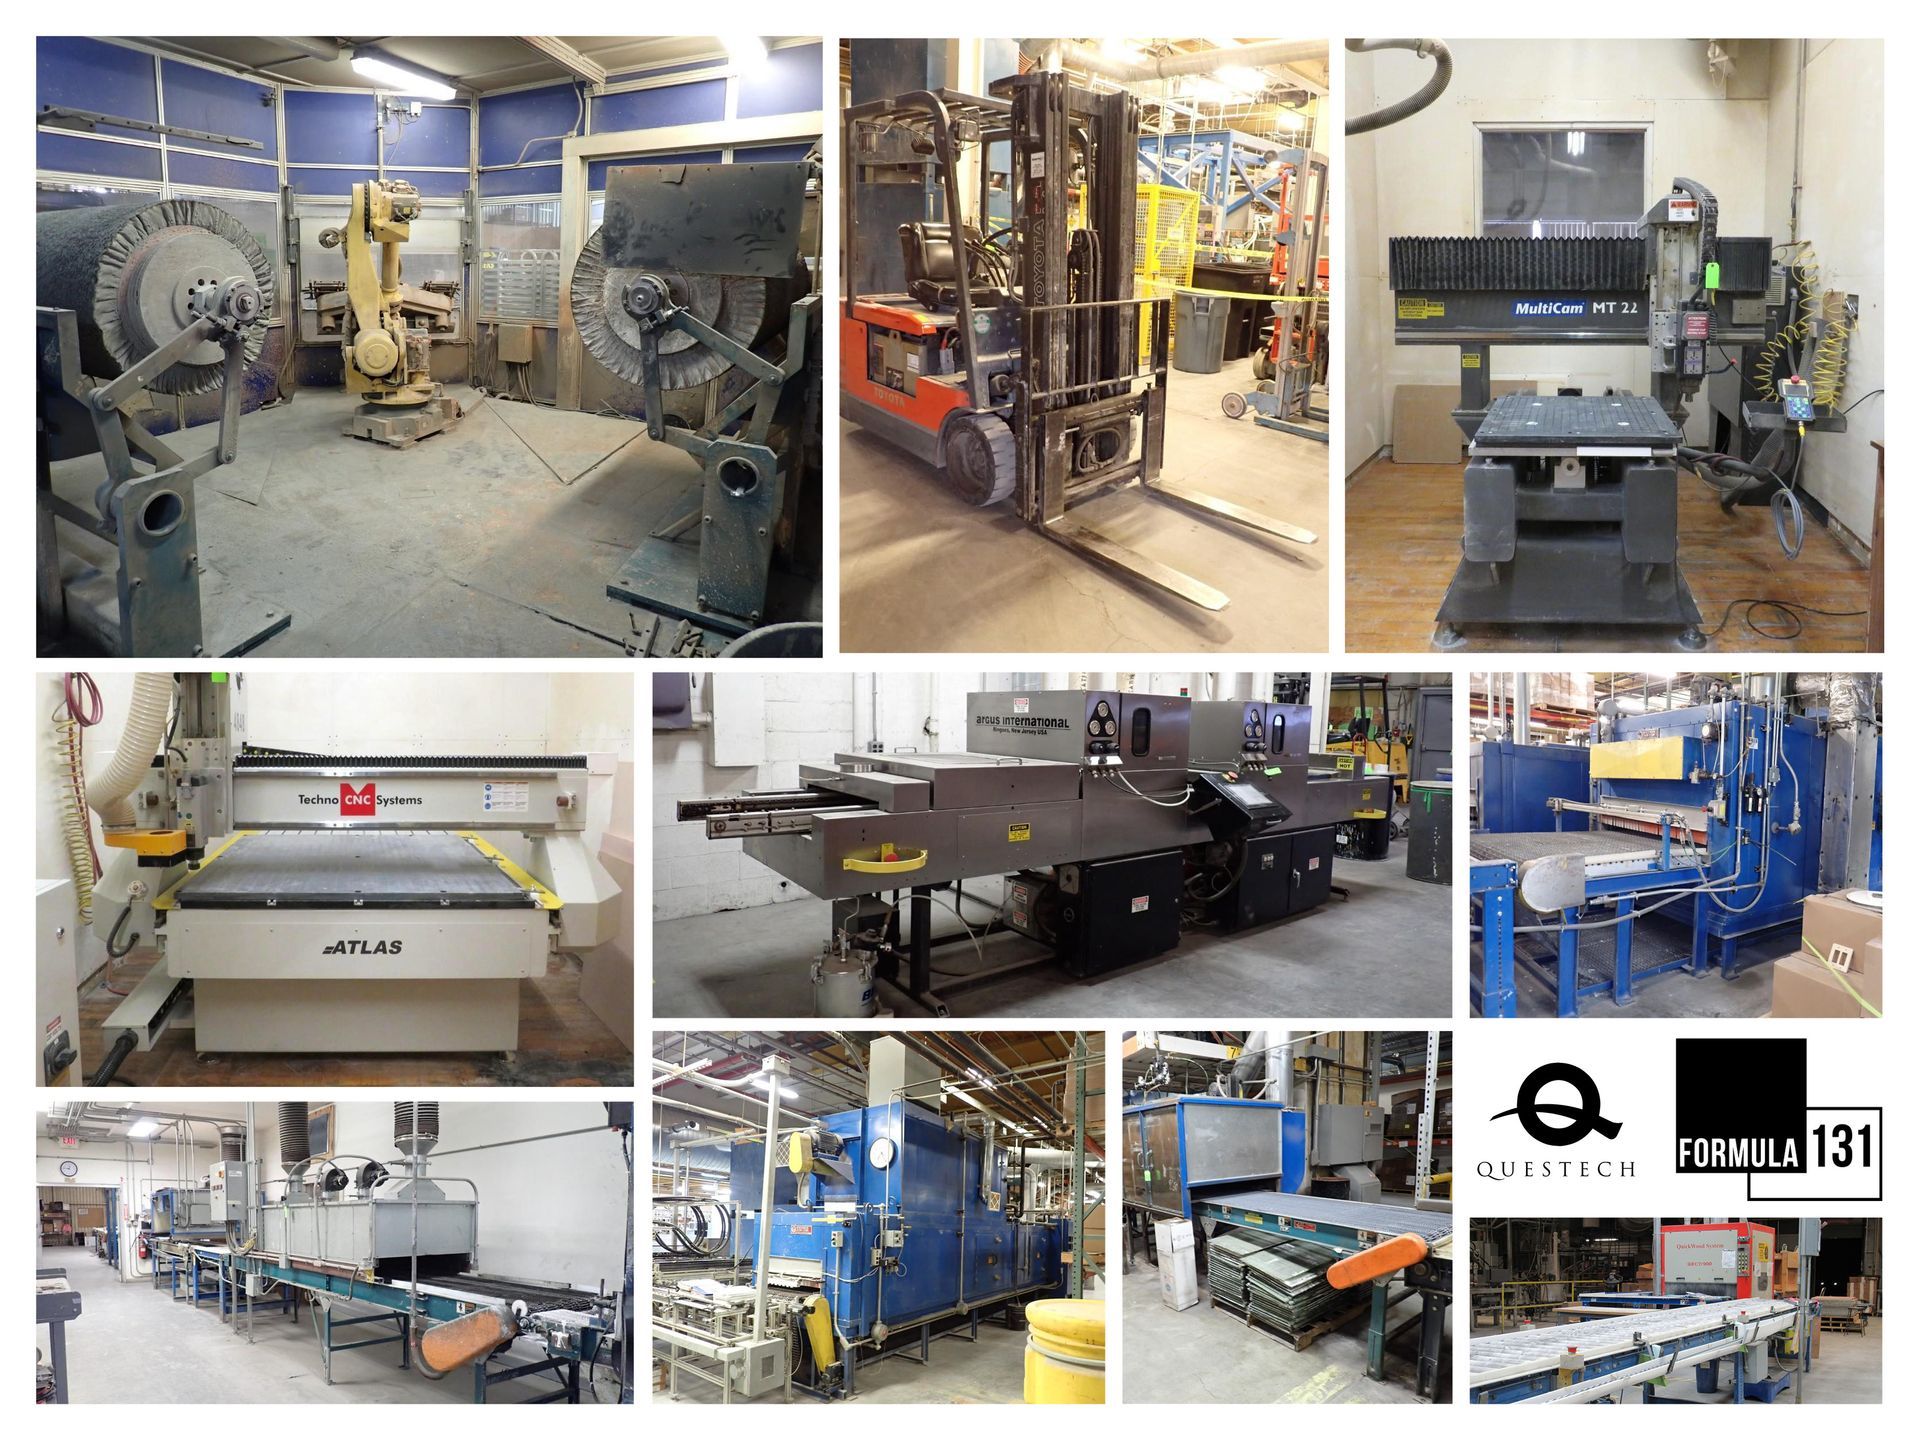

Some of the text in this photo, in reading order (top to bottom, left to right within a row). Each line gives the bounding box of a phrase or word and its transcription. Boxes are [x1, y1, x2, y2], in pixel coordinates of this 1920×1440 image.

[1033, 219, 1045, 307] TOYOTA
[1515, 302, 1638, 314] MultiCam MT 22
[874, 387, 905, 408] TOYOTA
[1021, 728, 1036, 736] Jersey
[299, 794, 423, 806] Techno CNC Systems
[332, 940, 402, 954] ATLAS
